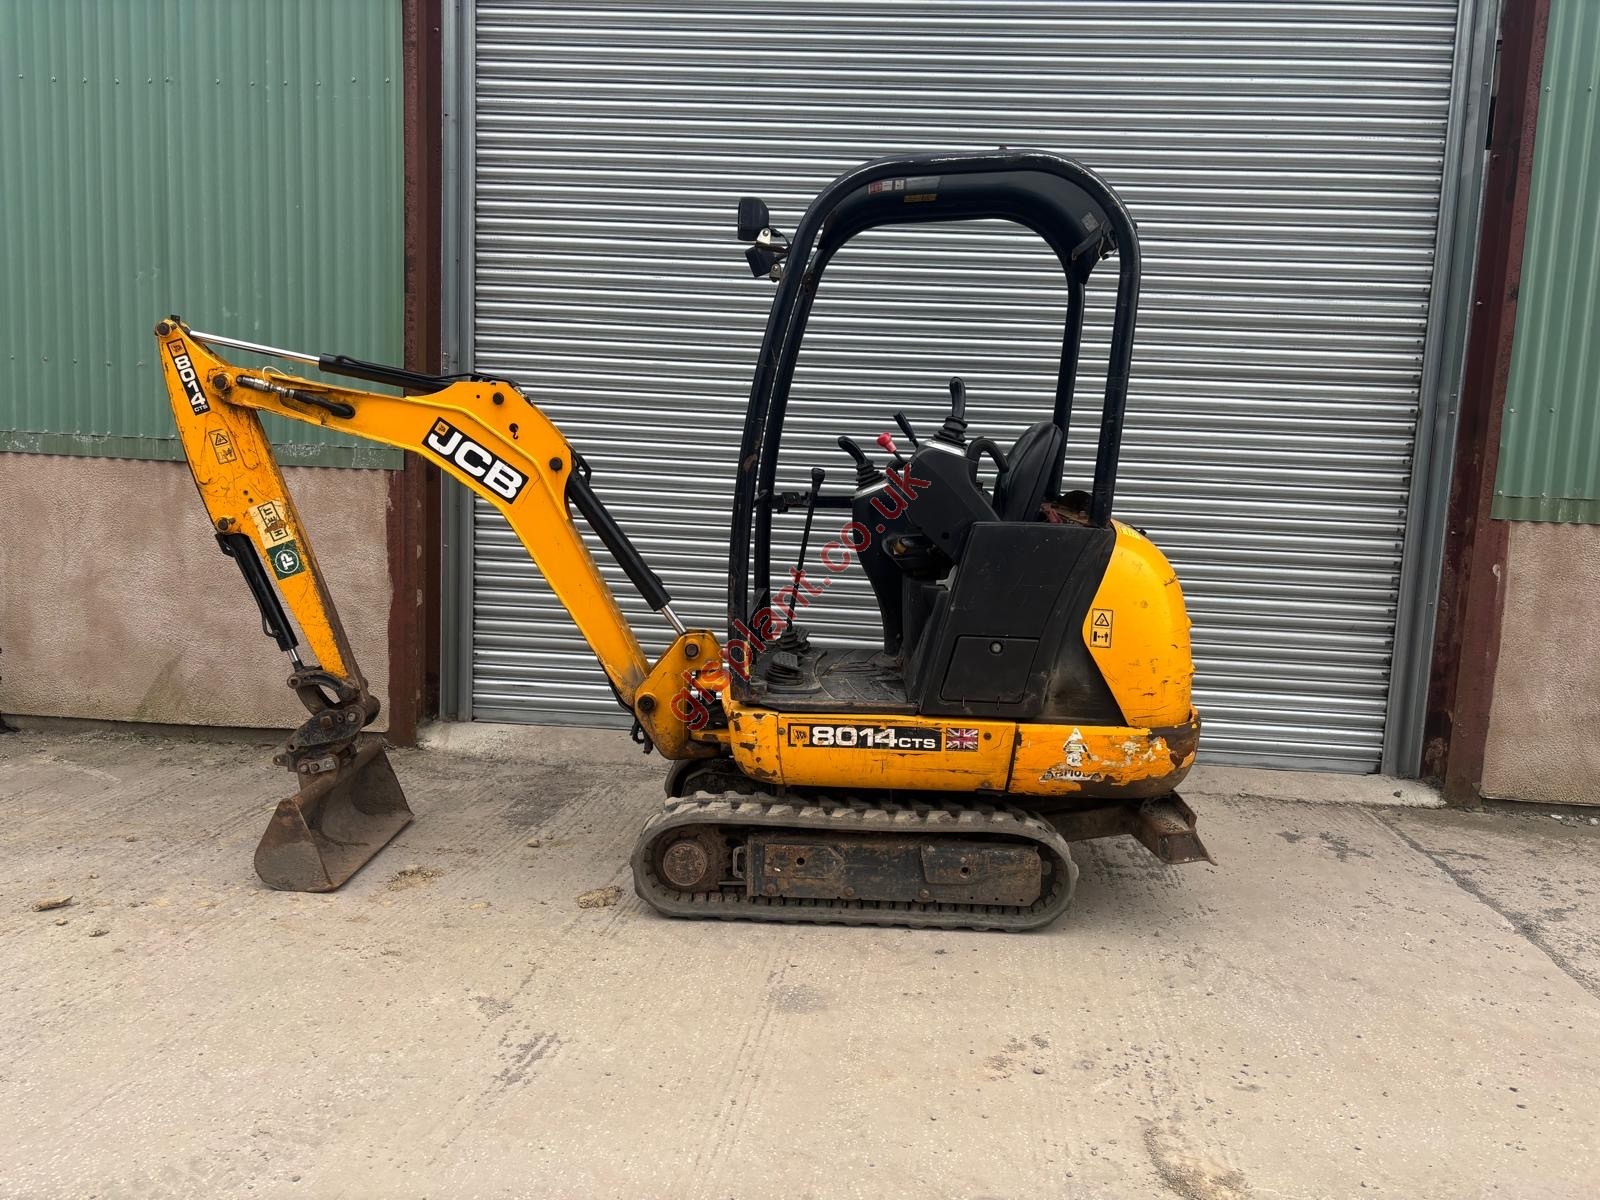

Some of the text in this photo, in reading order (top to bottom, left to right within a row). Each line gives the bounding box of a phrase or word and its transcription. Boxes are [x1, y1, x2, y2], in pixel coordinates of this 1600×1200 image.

[174, 354, 206, 406] 8014
[194, 404, 208, 413] CTS
[427, 431, 523, 499] JCB
[812, 726, 936, 749] 8014 CTS
